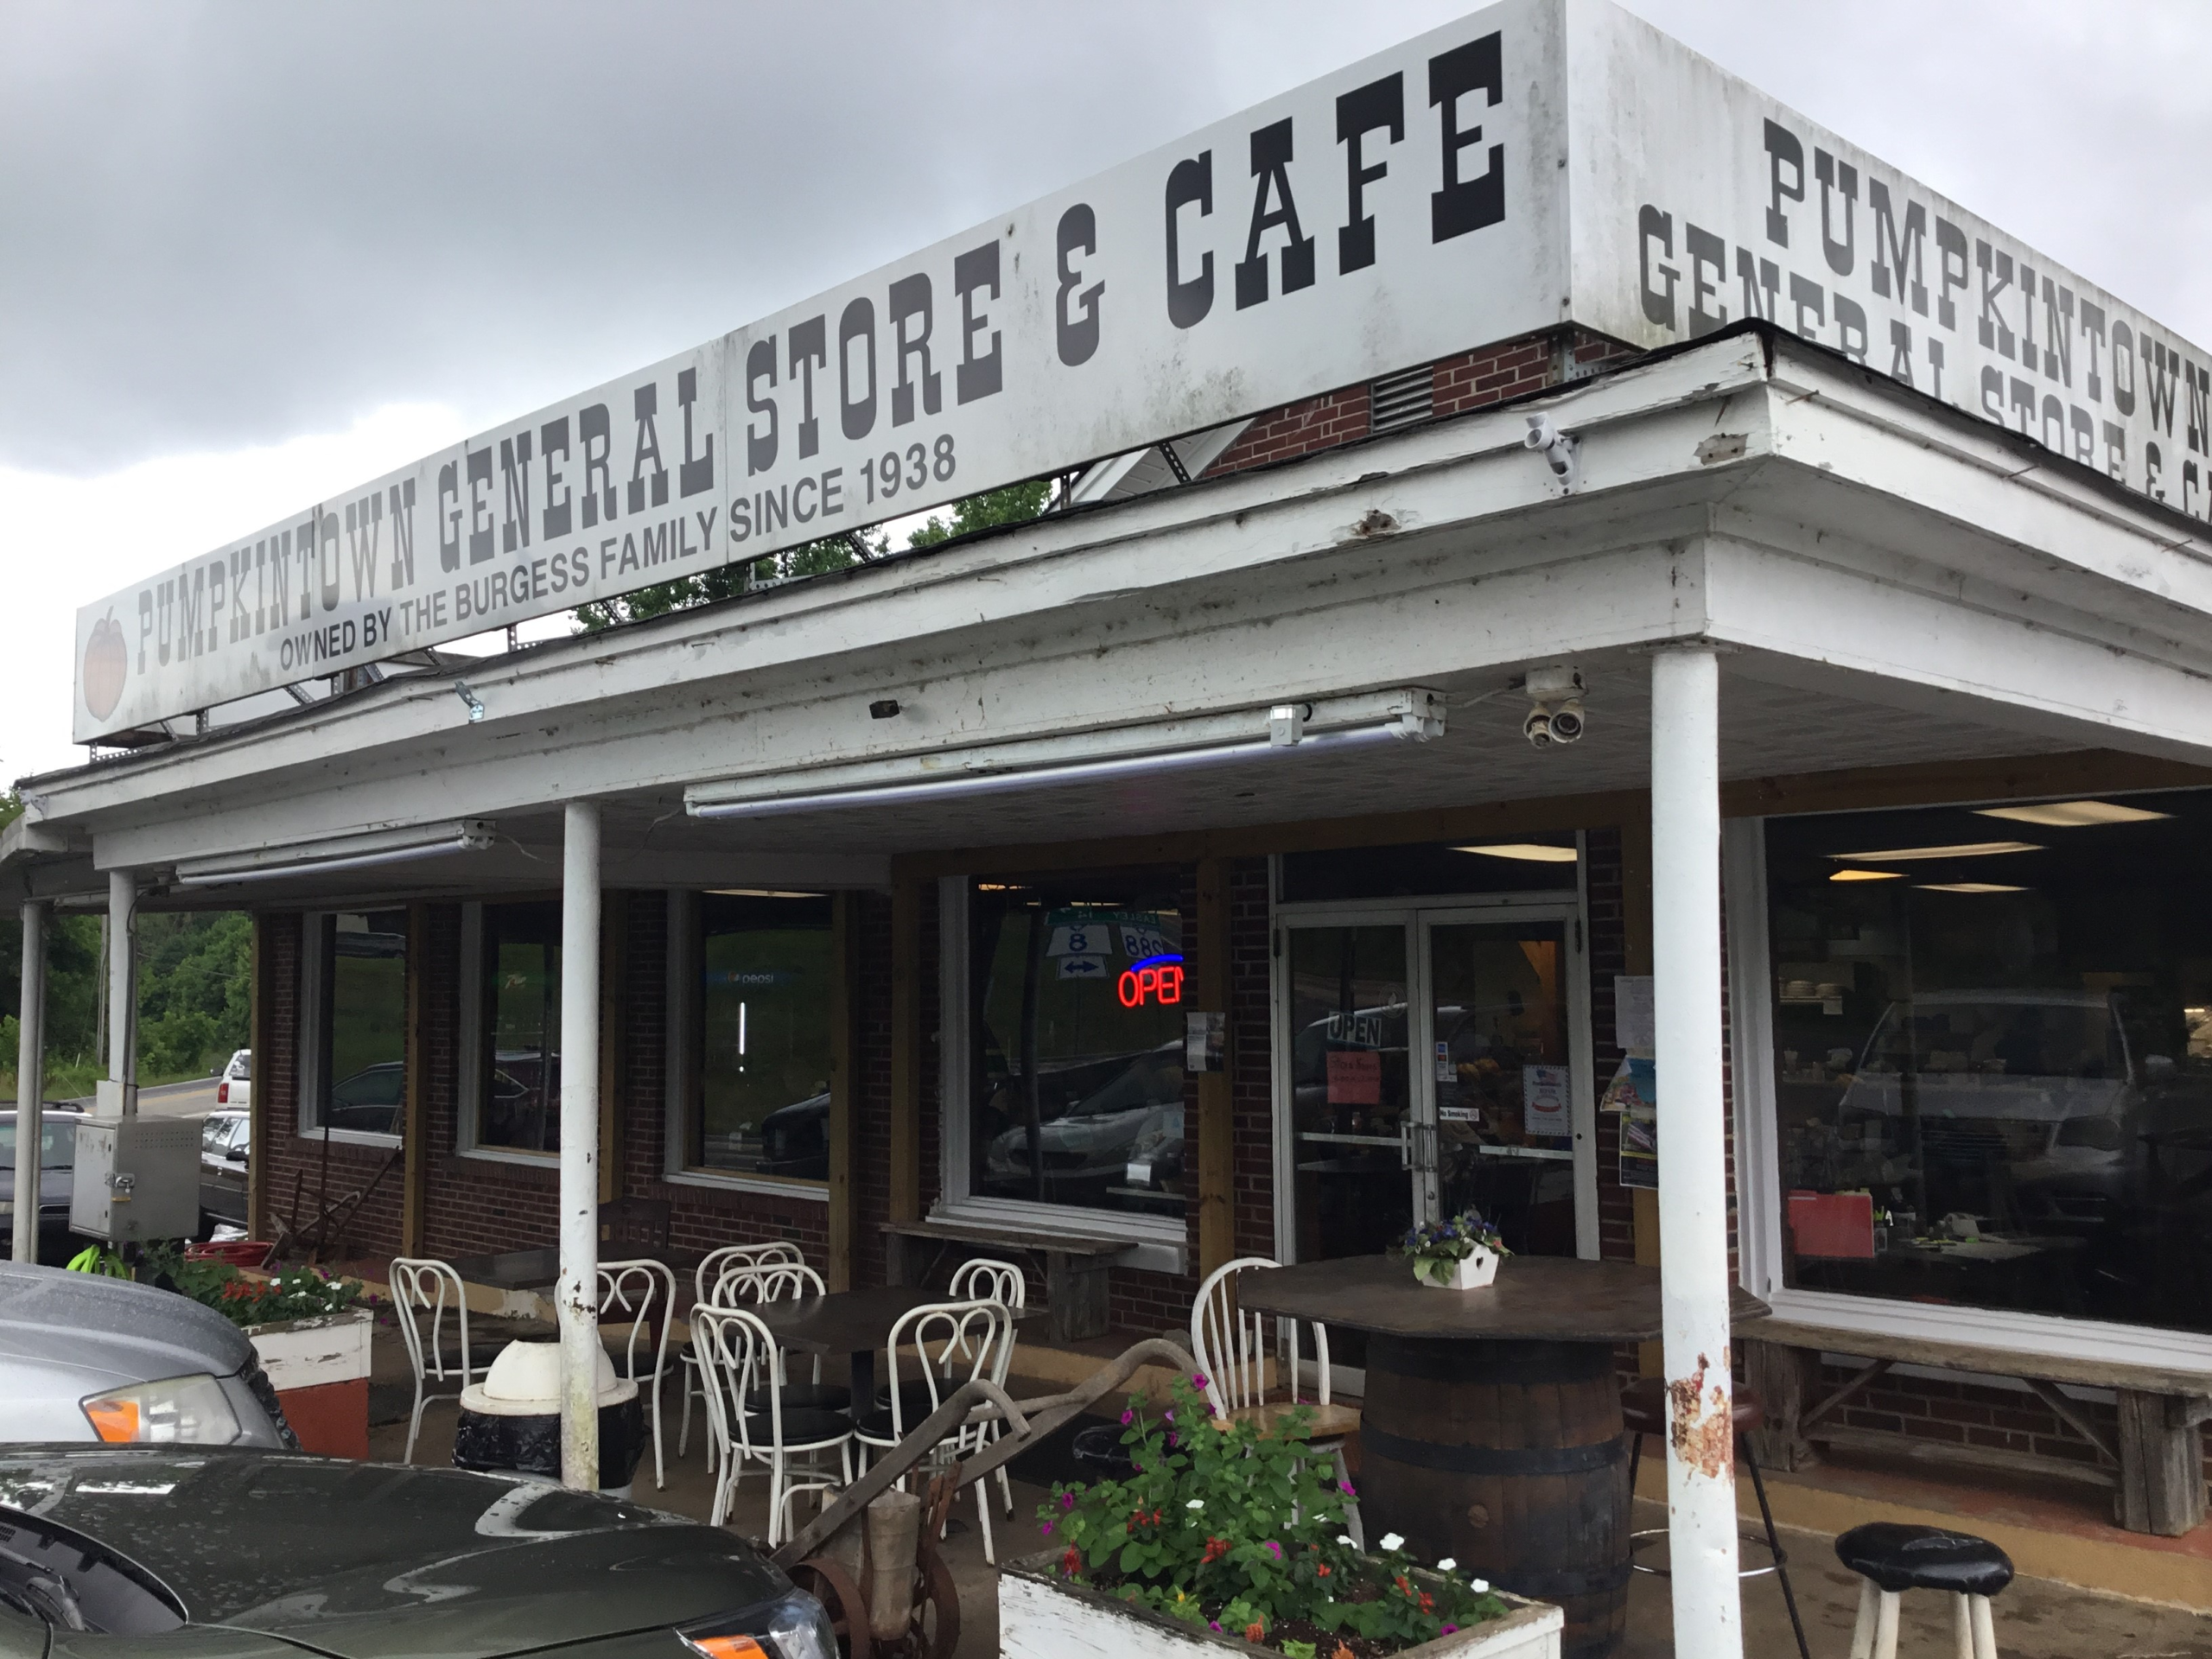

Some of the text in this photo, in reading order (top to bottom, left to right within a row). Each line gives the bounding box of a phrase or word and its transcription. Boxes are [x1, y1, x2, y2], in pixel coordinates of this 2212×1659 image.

[137, 30, 1506, 676] PUMPKINTOWN GENERAL STORE & CAFE
[1638, 203, 1957, 404] GENERAL
[1764, 117, 2210, 454] PUMPKINTOWN
[280, 433, 957, 671] OWNED BY THE BURGESS FAMILY SINCE 1938
[742, 972, 773, 984] pepsi
[1330, 1014, 1379, 1045] OPEN
[1447, 1109, 1469, 1119] Smoking
